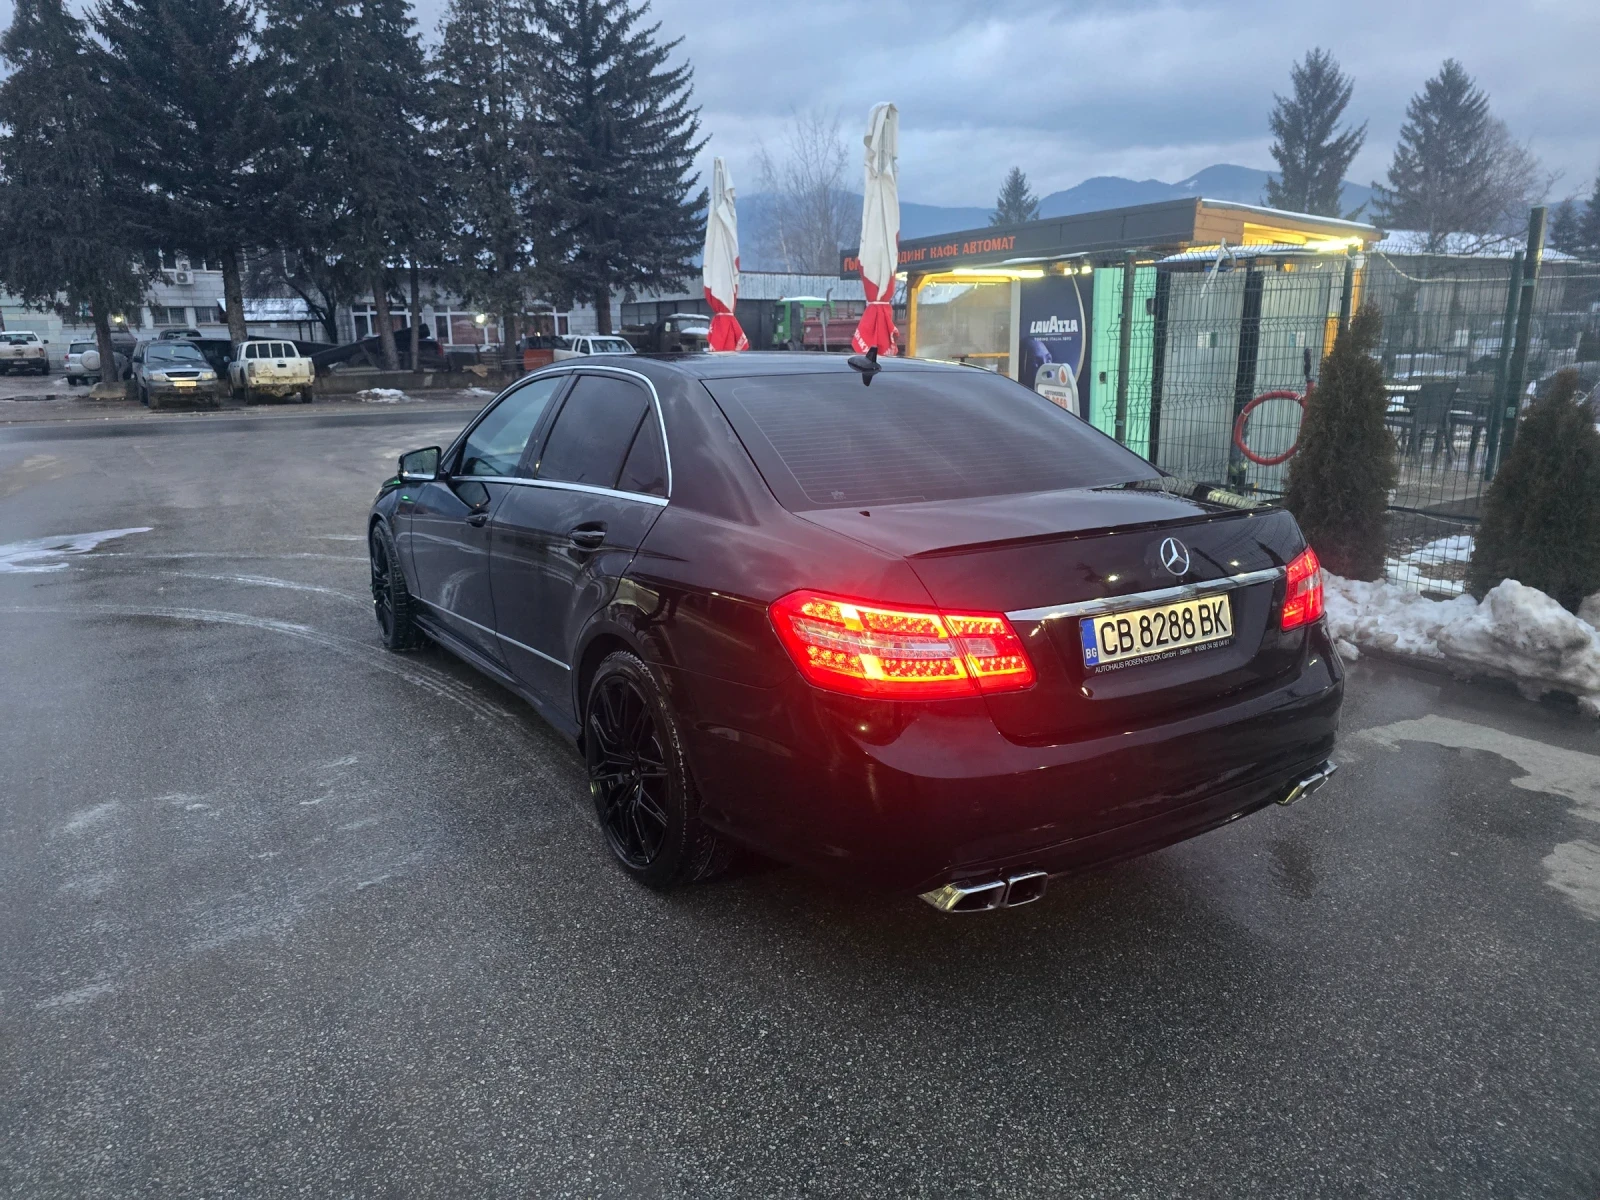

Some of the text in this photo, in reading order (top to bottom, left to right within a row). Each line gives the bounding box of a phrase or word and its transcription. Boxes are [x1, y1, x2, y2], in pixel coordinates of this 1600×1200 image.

[930, 243, 959, 259] КАФЕ
[962, 236, 1016, 255] АВТОМАТ
[1030, 316, 1078, 333] LAVAZZA
[1100, 600, 1228, 656] CB 8288 BK
[1085, 647, 1098, 659] BG
[1095, 662, 1124, 673] AUTOHAUS
[1125, 653, 1162, 667] ROSEN-STOCK
[1162, 650, 1177, 660] GmbH
